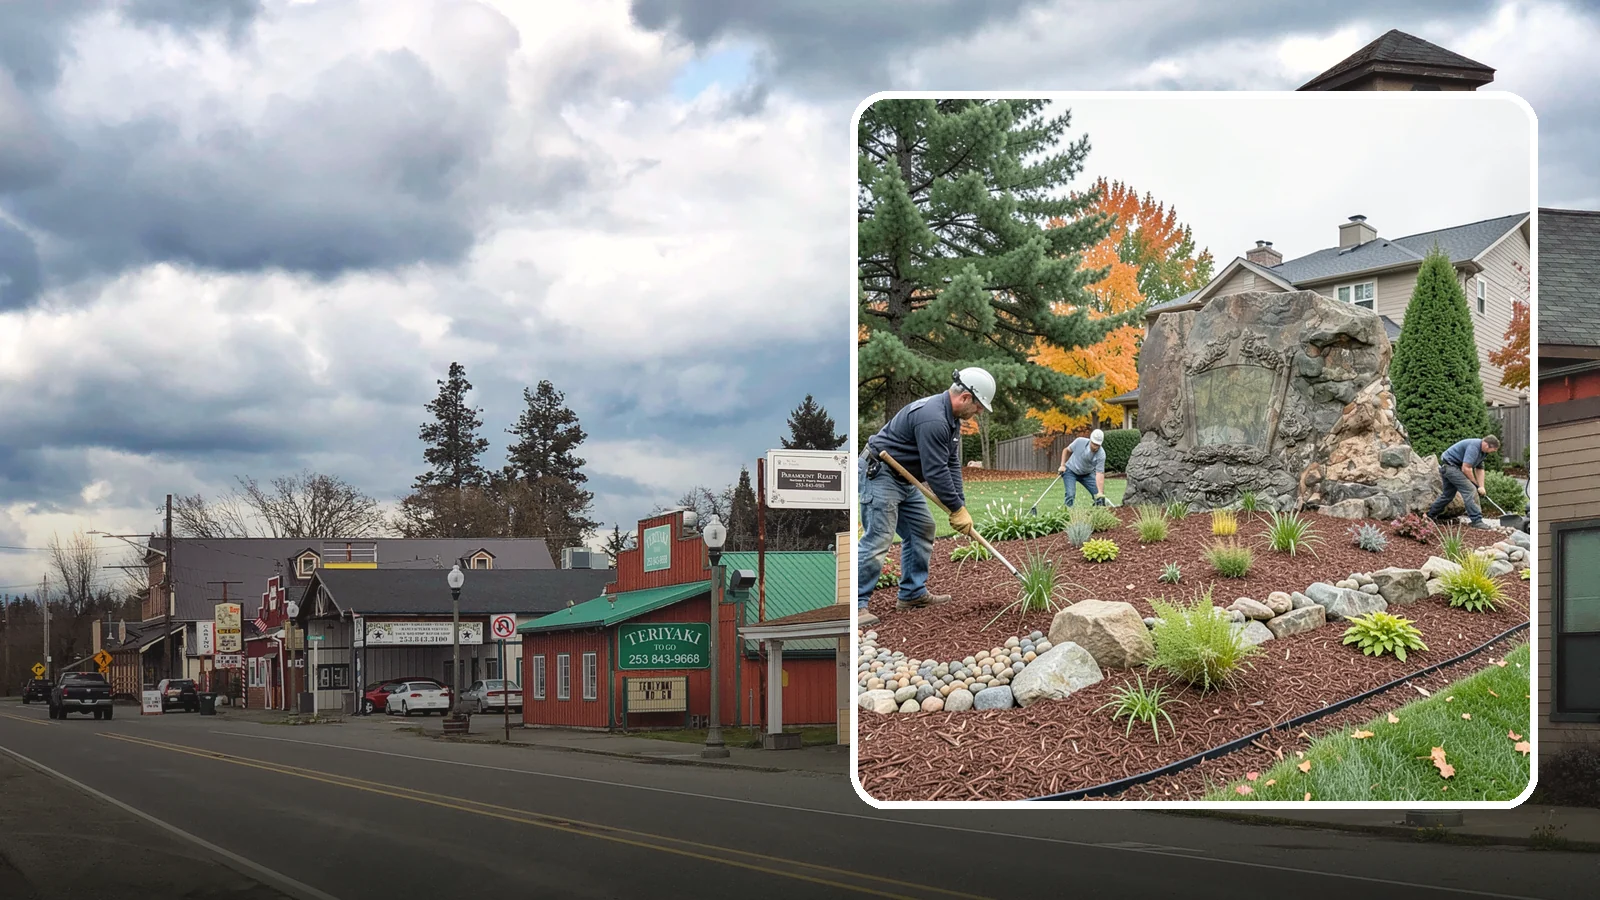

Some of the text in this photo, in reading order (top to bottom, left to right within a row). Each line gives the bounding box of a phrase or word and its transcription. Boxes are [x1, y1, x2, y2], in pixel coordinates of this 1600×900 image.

[625, 628, 702, 646] TERIYAKI
[629, 654, 700, 664] 253 843-9668
